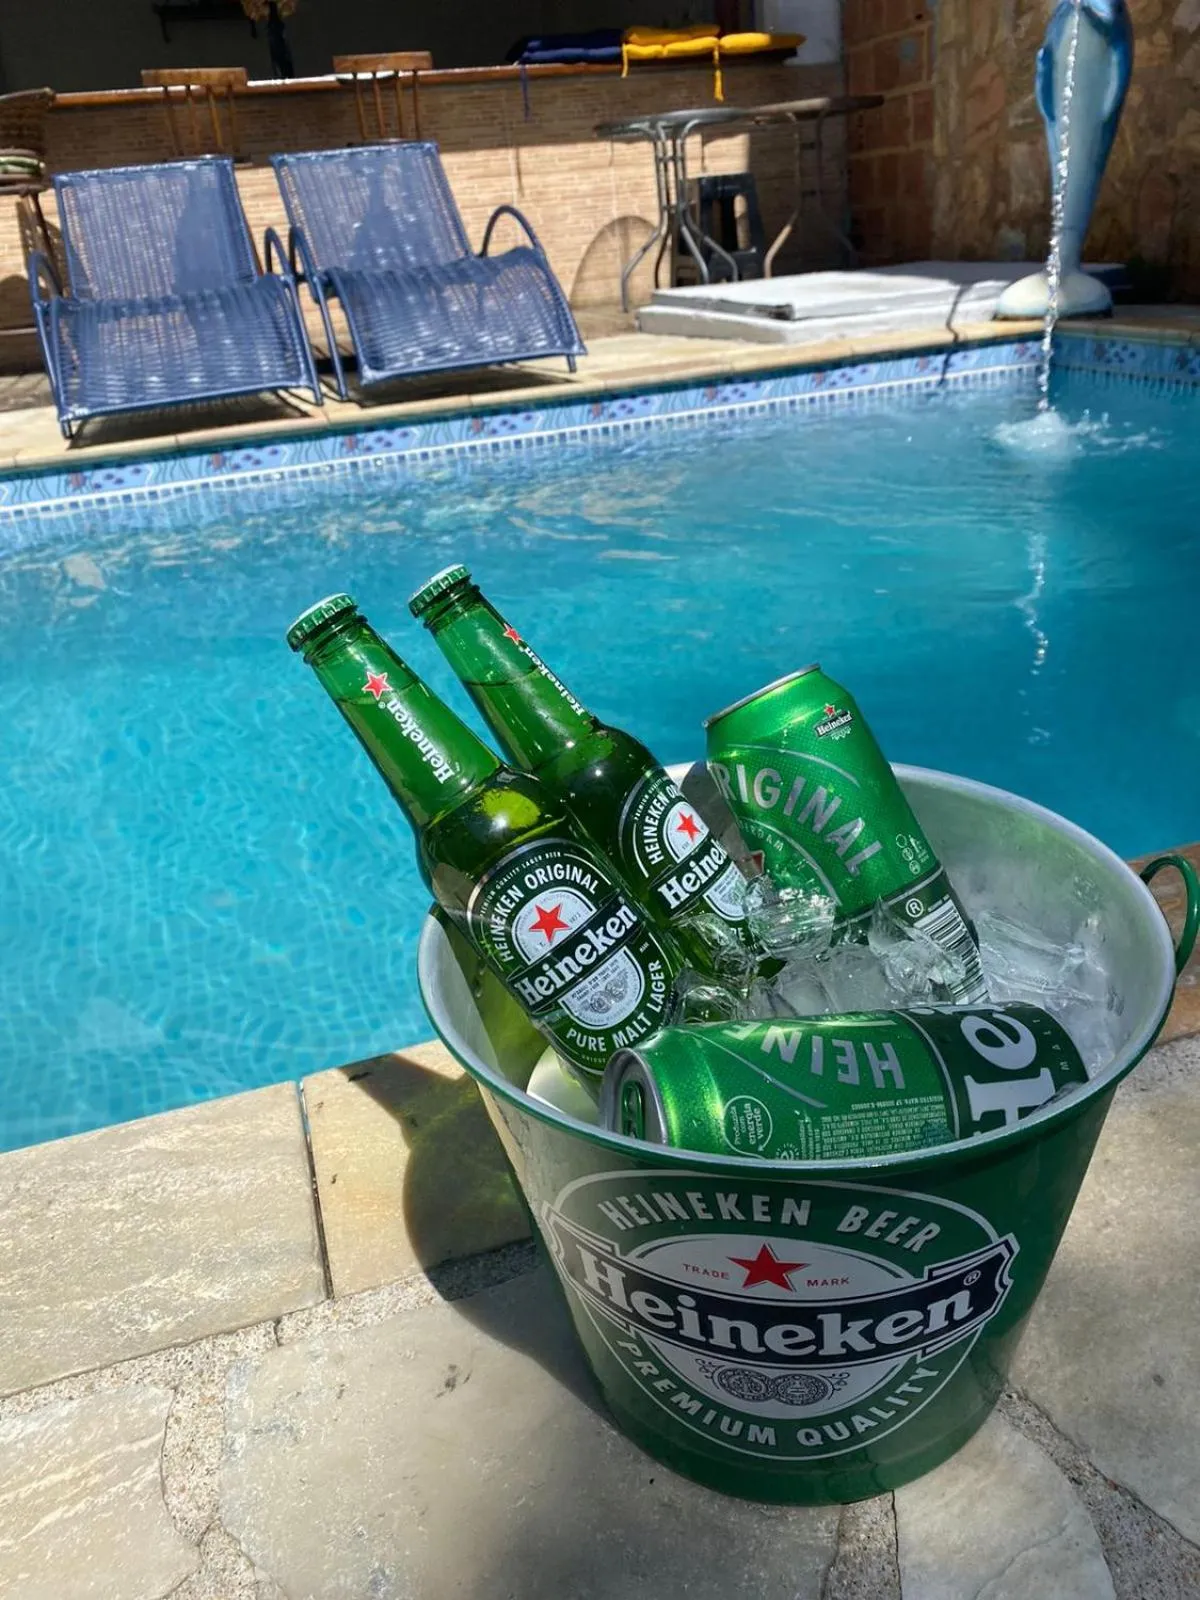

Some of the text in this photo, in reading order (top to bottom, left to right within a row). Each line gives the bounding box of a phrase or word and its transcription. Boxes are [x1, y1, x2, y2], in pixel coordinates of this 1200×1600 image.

[522, 647, 585, 716] Heineken
[386, 699, 454, 784] Heineken
[643, 791, 670, 865] HEINEKEN
[707, 762, 883, 877] RIGINAL
[496, 867, 520, 889] QUALITY
[522, 855, 543, 868] LAGER
[657, 838, 728, 910] Heinek
[490, 863, 598, 962] HEINEKEN ORIGINAL
[515, 904, 638, 1006] Heineken
[566, 1027, 607, 1052] PURE
[611, 1012, 652, 1048] MALT
[646, 960, 666, 1013] LAGER
[722, 1022, 906, 1089] HEINE
[743, 1103, 757, 1145] energia
[753, 1107, 764, 1140] verde
[598, 1192, 941, 1253] HEINEKEN BEER
[575, 1243, 974, 1358] Heineken
[683, 1263, 850, 1288] TRADE MARK
[617, 1339, 942, 1446] PREMIUM QUALITY
